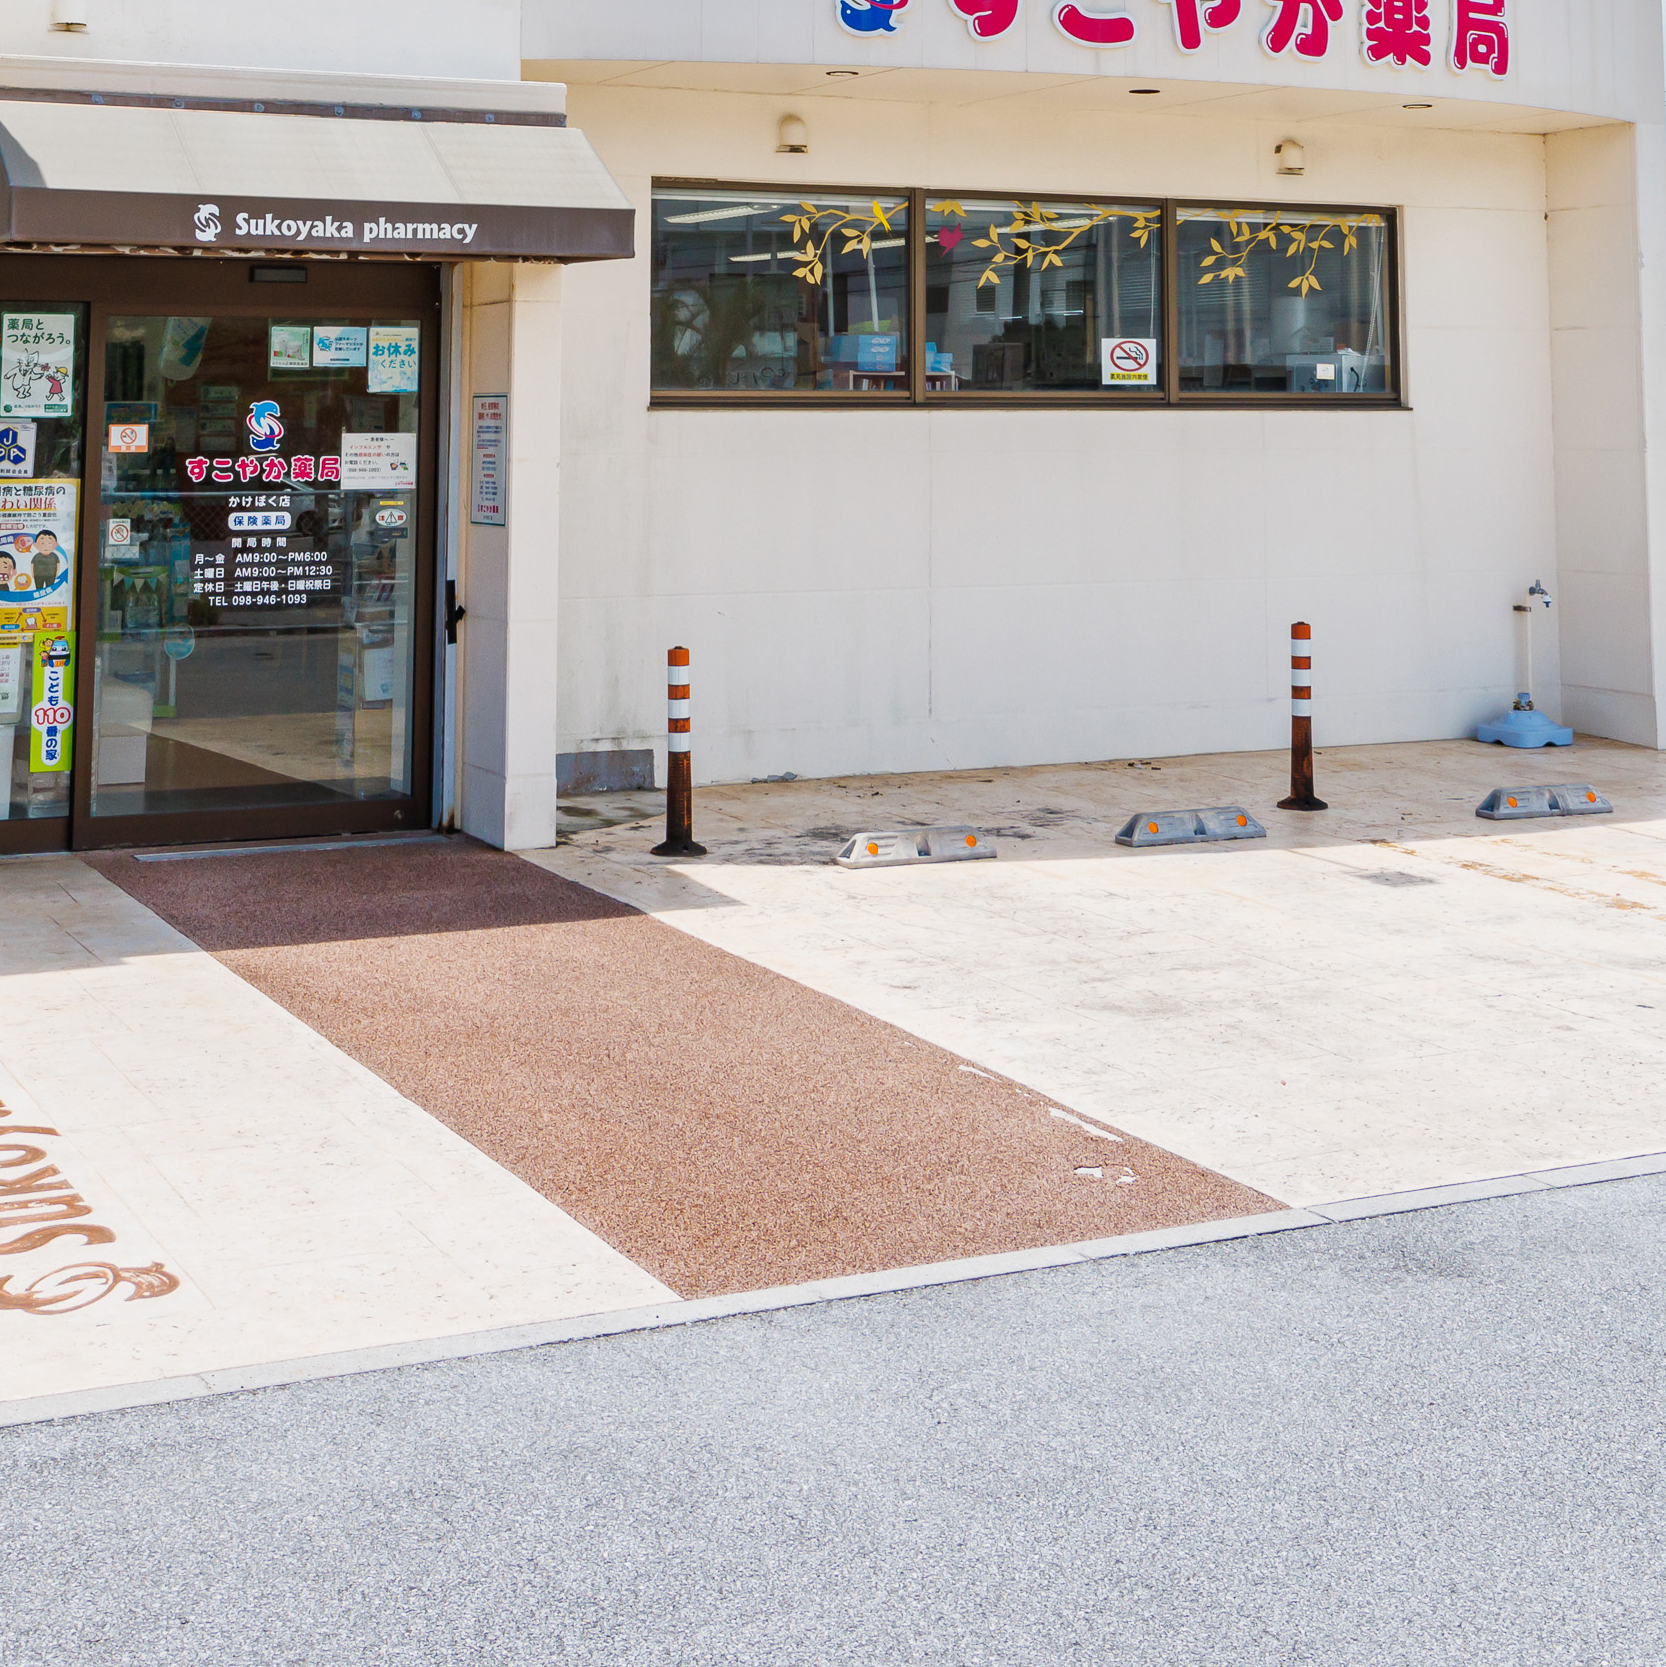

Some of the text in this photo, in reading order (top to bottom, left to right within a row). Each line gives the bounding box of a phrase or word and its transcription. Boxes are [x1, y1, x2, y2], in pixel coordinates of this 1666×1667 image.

[235, 212, 478, 243] Sukoyaka pharmacy
[7, 318, 45, 330] 薬局と
[7, 332, 71, 345] つながろう。
[372, 342, 417, 358] お休み
[380, 359, 417, 369] ください
[186, 455, 340, 482] すこやか薬局
[228, 495, 291, 508] かけぼく店
[233, 515, 286, 527] 保険薬局
[231, 537, 287, 548] 開局時間
[194, 568, 225, 579] 土曜日
[193, 582, 225, 594] 定休日
[208, 594, 307, 607] TEL 098-946-1093
